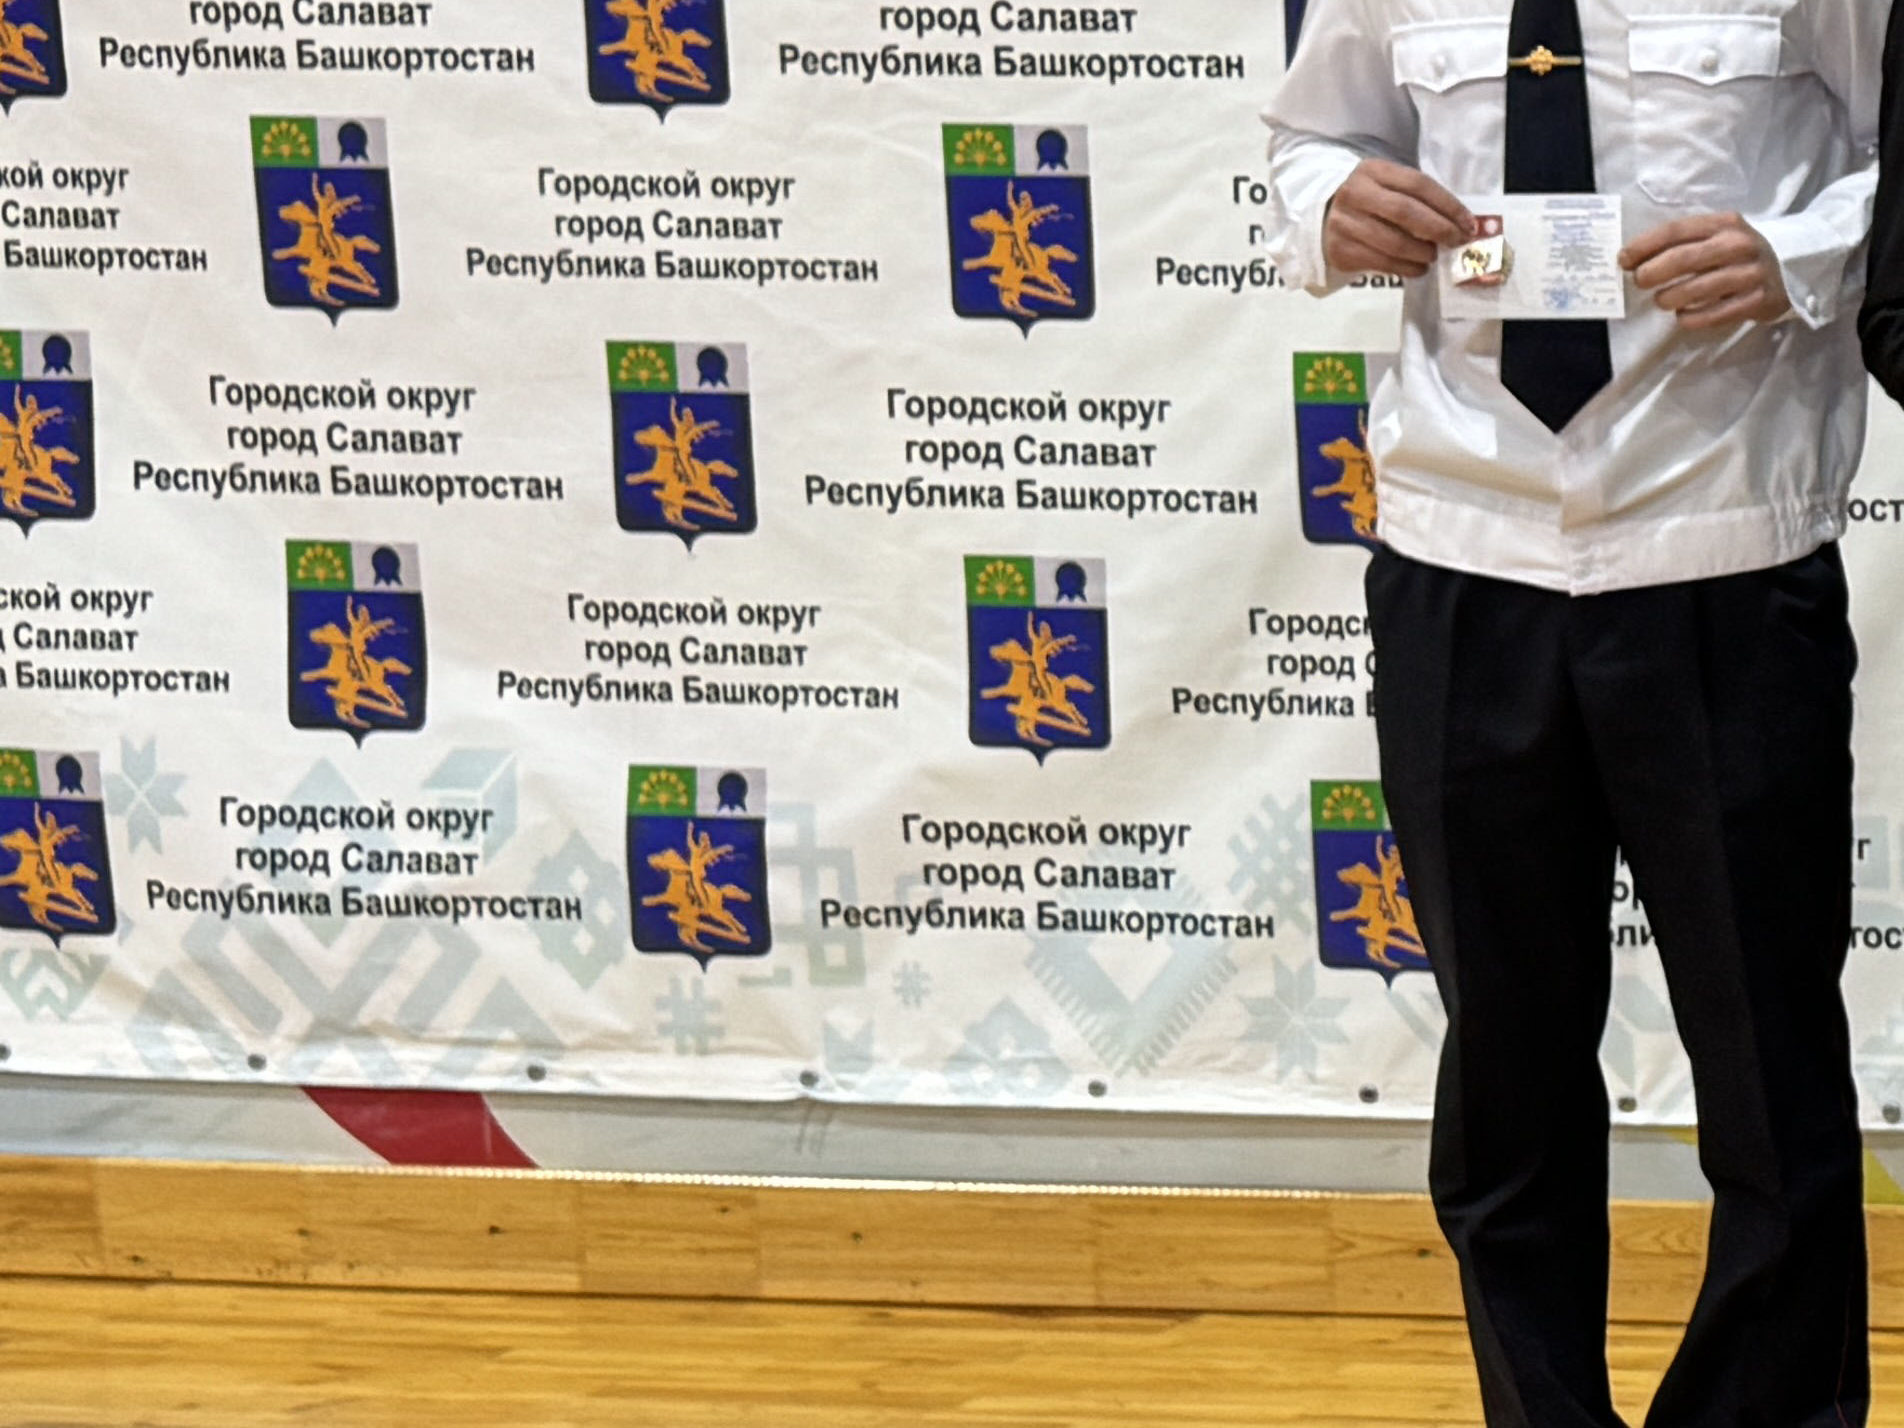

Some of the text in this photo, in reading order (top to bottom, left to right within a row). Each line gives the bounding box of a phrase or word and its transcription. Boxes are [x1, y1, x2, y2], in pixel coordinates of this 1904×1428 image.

[189, 0, 284, 34] город
[879, 0, 1138, 39] город Салават
[99, 36, 535, 79] Республика Башкортостан
[779, 43, 1245, 86] Республика Башкортостан
[52, 167, 130, 197] округ
[538, 167, 796, 207] Городской округ
[1, 199, 121, 230] Салават
[554, 209, 783, 244] город Салават
[3, 239, 208, 277] Башкортостан
[466, 247, 879, 287] Республика Башкортостан
[209, 374, 476, 419] Городской округ
[887, 387, 1171, 431] Городской округ
[227, 421, 463, 457] город Салават
[905, 434, 1157, 472] город Салават
[133, 460, 564, 506] Республика Башкортостан
[805, 474, 1258, 519] Республика Башкортостан
[70, 589, 154, 619] округ
[567, 593, 821, 634] Городской округ
[12, 621, 139, 652] Салават
[584, 635, 808, 669] город Салават
[15, 660, 230, 698] Башкортостан
[1267, 654, 1356, 683] город
[497, 670, 899, 713] Республика Башкортостан
[1171, 687, 1355, 722] Республика
[219, 796, 494, 841] Городской округ
[901, 813, 1192, 855] Городской округ
[235, 841, 479, 879] город Салават
[922, 856, 1176, 894] город Салават
[146, 879, 583, 925] Республика Башкортостан
[820, 897, 1275, 942] Республика Башкортостан
